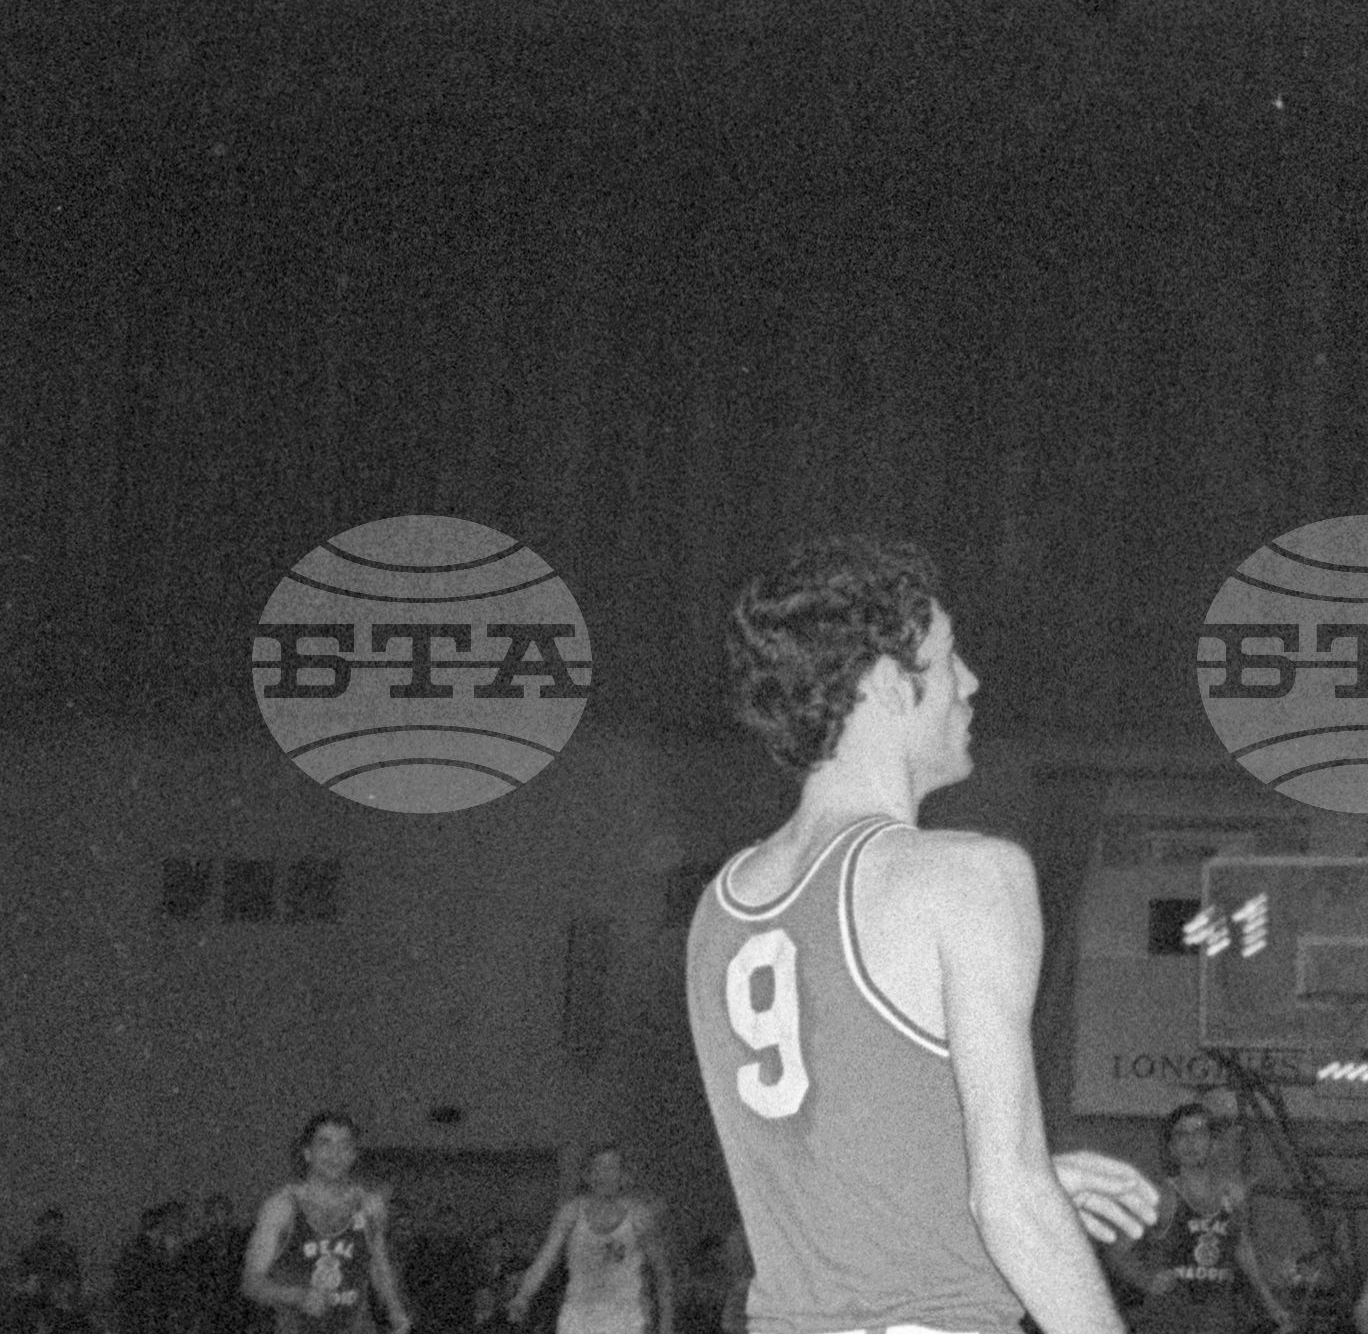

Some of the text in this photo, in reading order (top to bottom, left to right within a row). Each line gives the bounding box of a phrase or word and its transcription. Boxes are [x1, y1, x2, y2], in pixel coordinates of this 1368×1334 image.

[726, 929, 809, 1118] 9
[1112, 1052, 1299, 1080] LONGES
[303, 1239, 354, 1259] REAL
